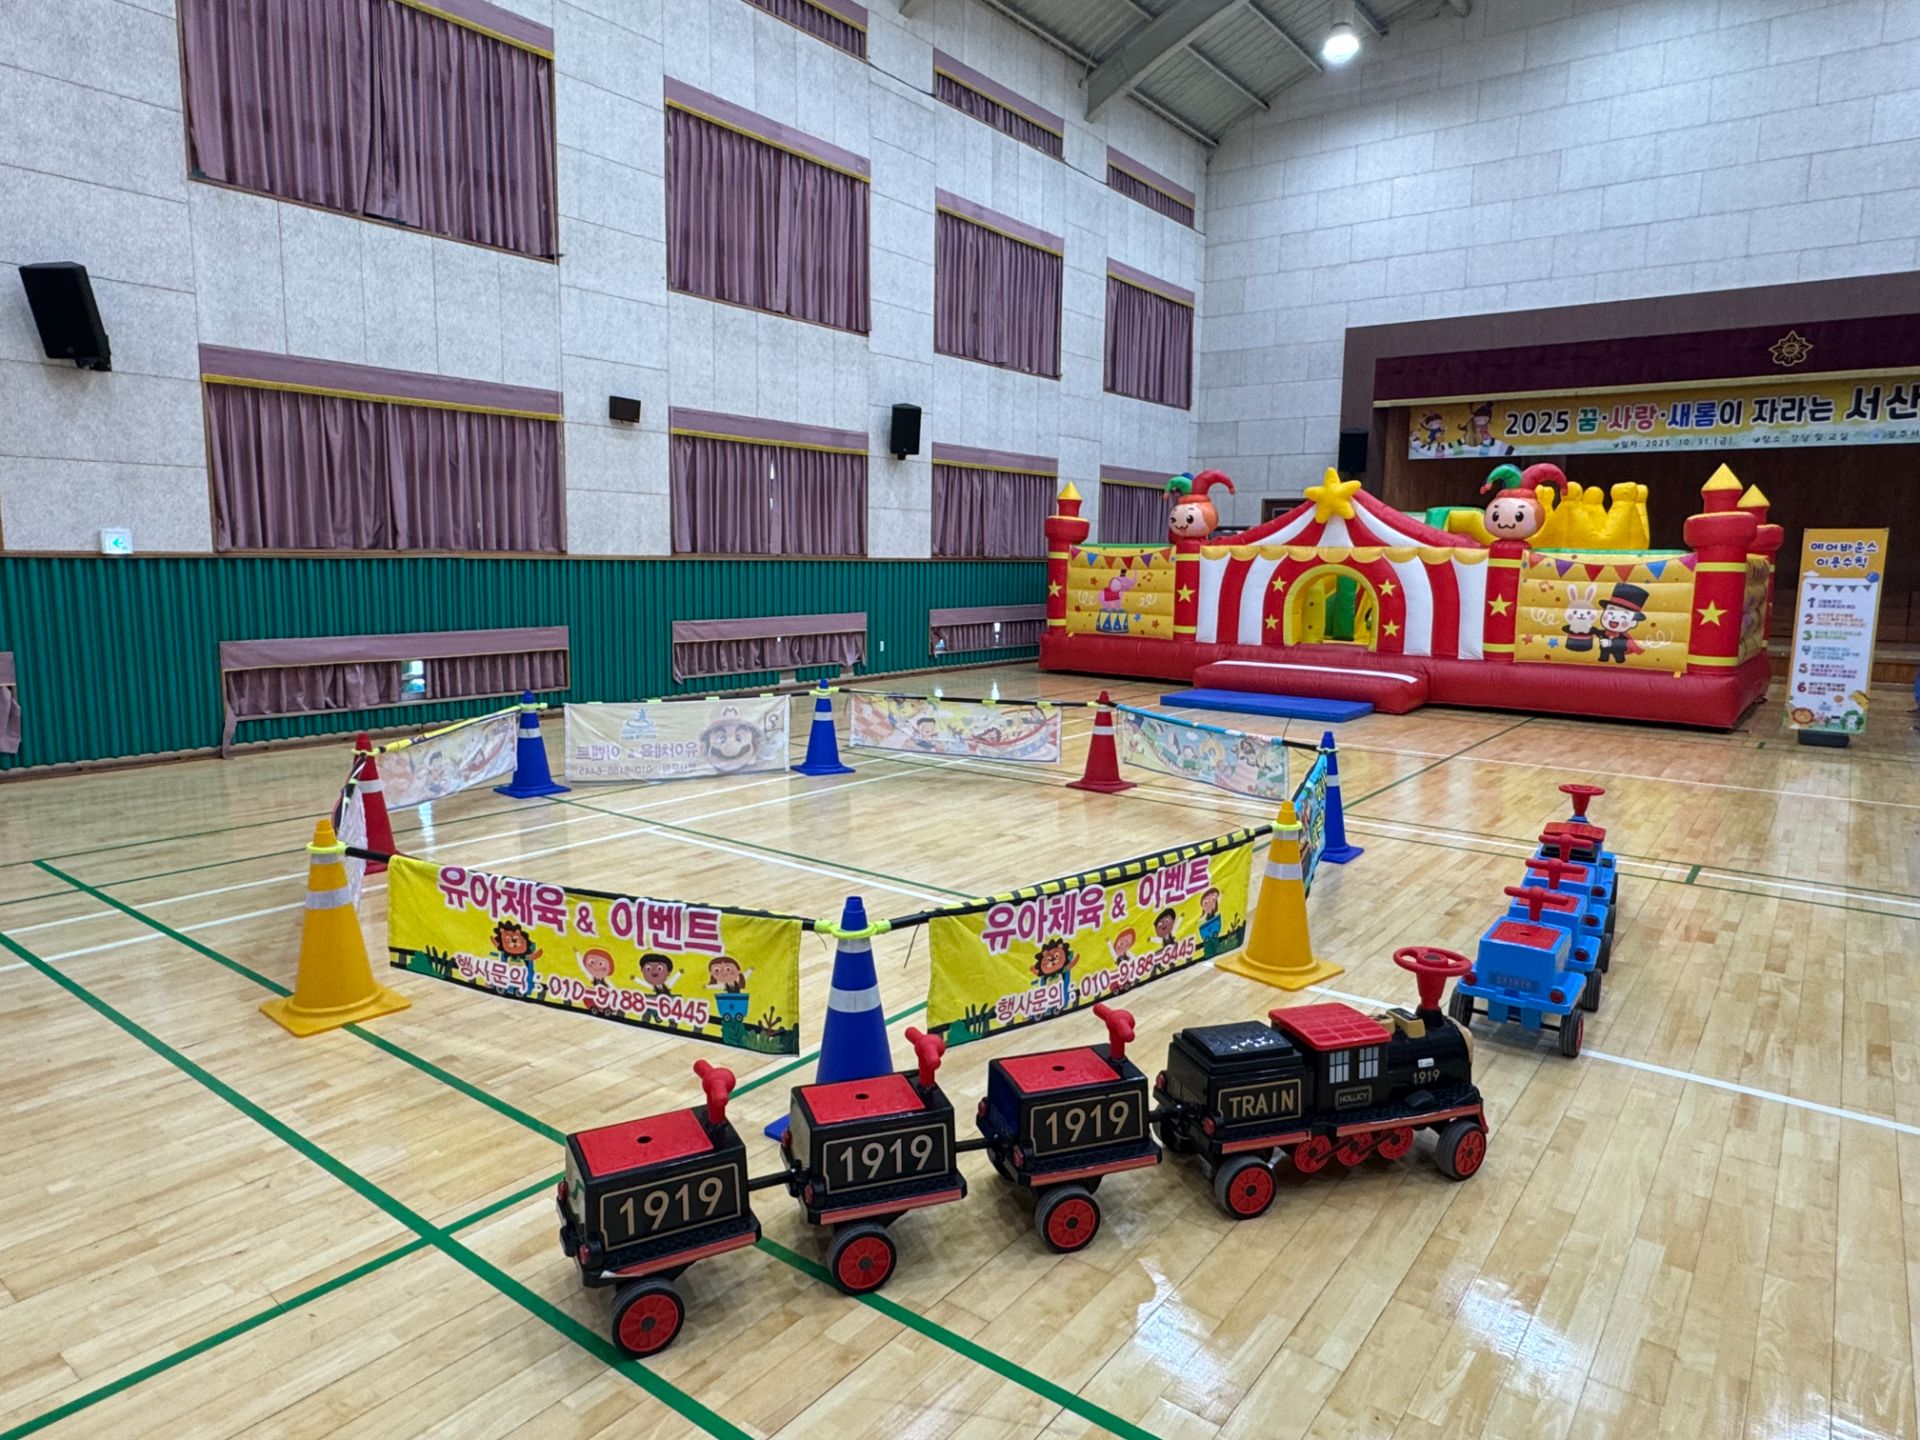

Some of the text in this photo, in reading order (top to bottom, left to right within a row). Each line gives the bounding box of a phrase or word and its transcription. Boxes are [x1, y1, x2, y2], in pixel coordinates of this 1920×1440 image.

[1505, 410, 1569, 435] 2025
[1752, 396, 1834, 424] 자라는
[1845, 384, 1920, 421] 서산
[1810, 541, 1877, 554] 에어바운스
[1816, 556, 1868, 569] 이용수칙
[1808, 597, 1815, 608] 1
[1804, 613, 1814, 624] 2
[1802, 630, 1812, 641] 3
[1799, 663, 1808, 673] 5
[1797, 681, 1806, 692] 6
[439, 865, 722, 952] 유아체육 & 이벤트
[981, 857, 1210, 951] 유아체육 & 이벤트
[456, 954, 526, 991] 행사문의
[549, 975, 708, 1025] 010-9188-6445
[997, 983, 1063, 1021] 행사문의
[1081, 937, 1195, 997] 010-9188-6445
[1412, 1069, 1440, 1085] 1919
[1229, 1088, 1294, 1119] TRAIN
[1045, 1099, 1129, 1146] 1919
[839, 1134, 933, 1183] 1919
[618, 1176, 724, 1236] 1919
